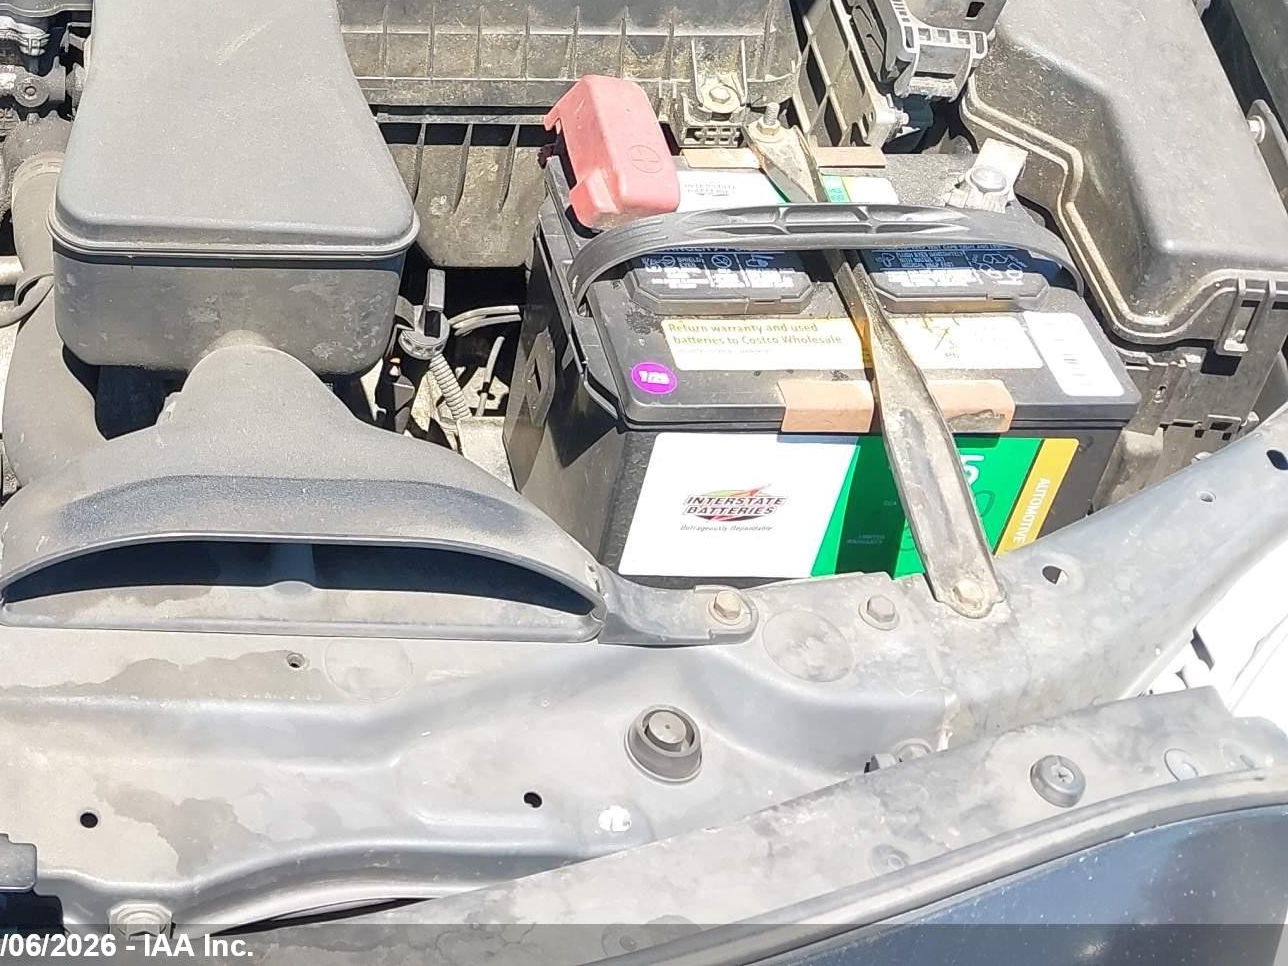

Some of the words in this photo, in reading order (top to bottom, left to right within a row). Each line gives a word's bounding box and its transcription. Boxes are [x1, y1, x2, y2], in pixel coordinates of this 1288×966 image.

[668, 323, 708, 332] Return
[712, 324, 762, 334] warranty
[766, 323, 788, 332] and
[791, 323, 818, 332] used
[673, 335, 724, 344] batteries
[727, 337, 739, 345] to
[741, 336, 779, 345] Costco
[782, 335, 843, 344] Wholesale
[684, 496, 786, 505] INTERSTATE
[686, 506, 776, 515] BATTERIES
[1013, 477, 1051, 544] AUTOMOTIVE
